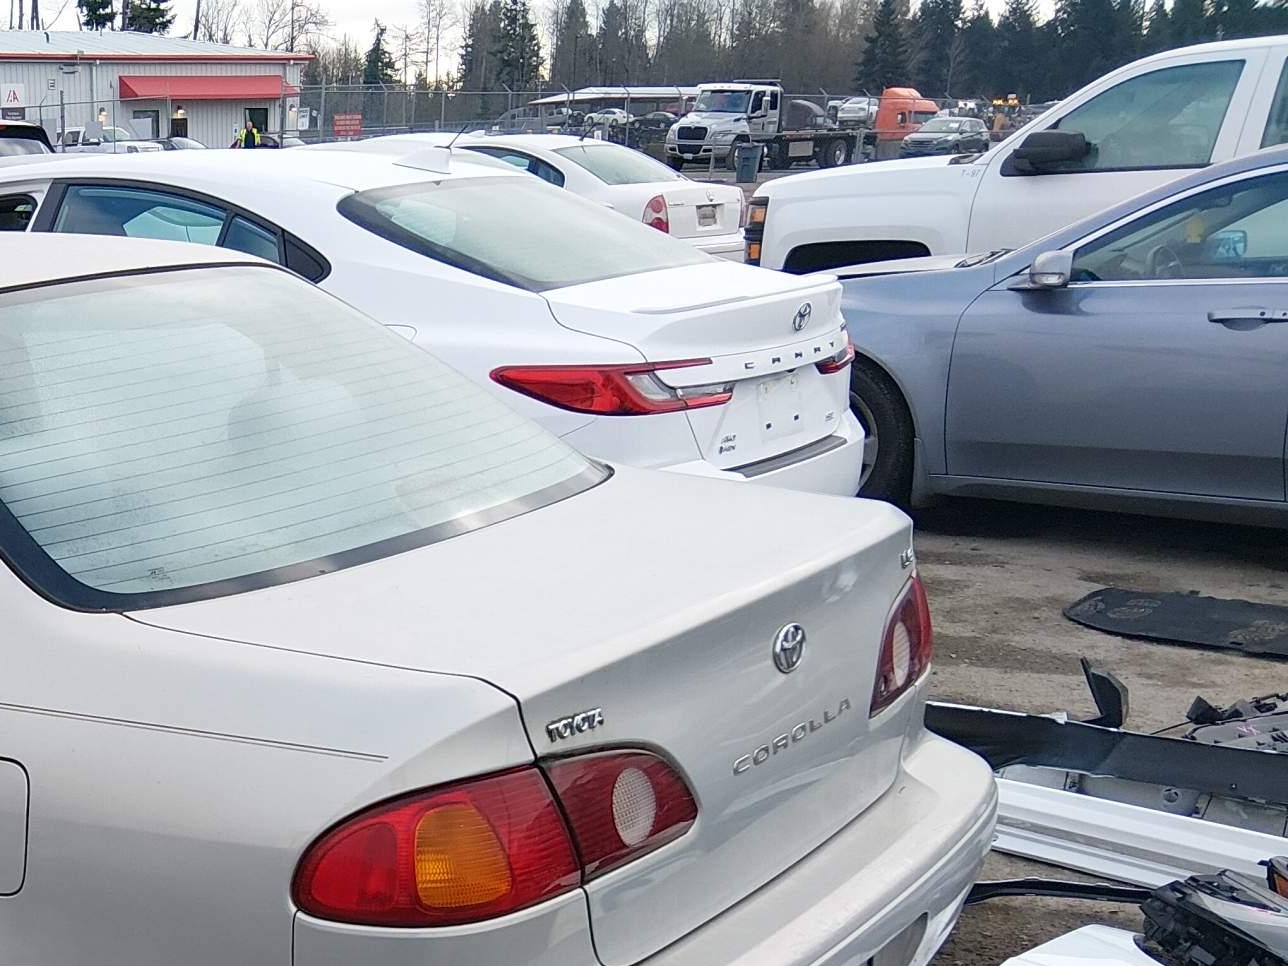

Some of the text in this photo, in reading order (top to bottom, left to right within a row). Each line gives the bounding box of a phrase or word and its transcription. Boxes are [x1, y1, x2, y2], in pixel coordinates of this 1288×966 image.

[744, 341, 835, 370] CAMRY
[546, 707, 604, 743] TOYOTA
[732, 697, 852, 777] COROLLA
